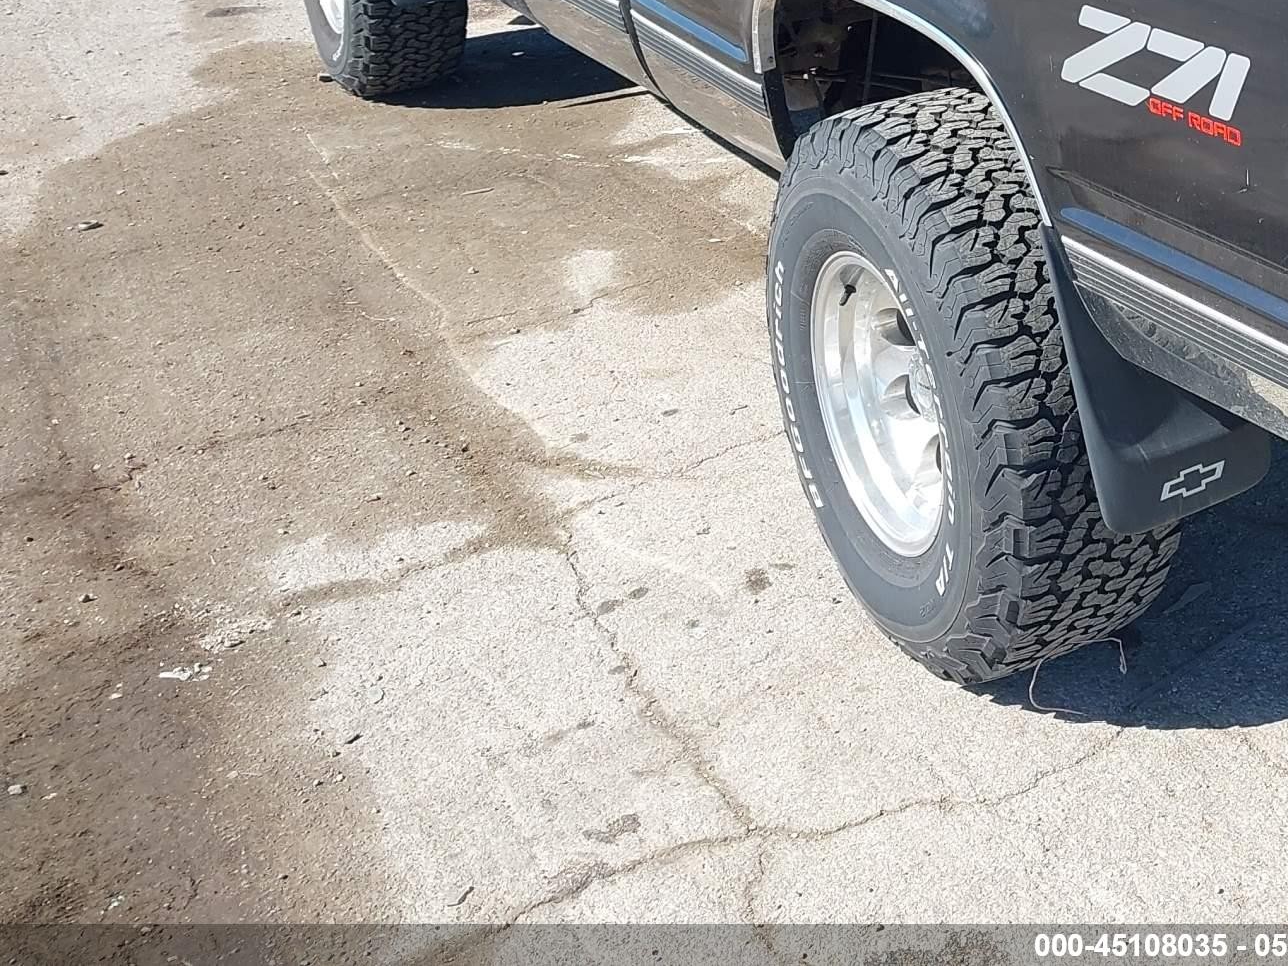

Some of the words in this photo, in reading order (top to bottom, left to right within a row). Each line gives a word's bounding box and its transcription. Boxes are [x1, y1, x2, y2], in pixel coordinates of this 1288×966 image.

[1061, 4, 1251, 122] Z71
[1149, 97, 1184, 121] OFF
[1188, 111, 1242, 146] ROAD
[774, 260, 824, 509] BFGoodrich
[935, 542, 954, 596] T/A
